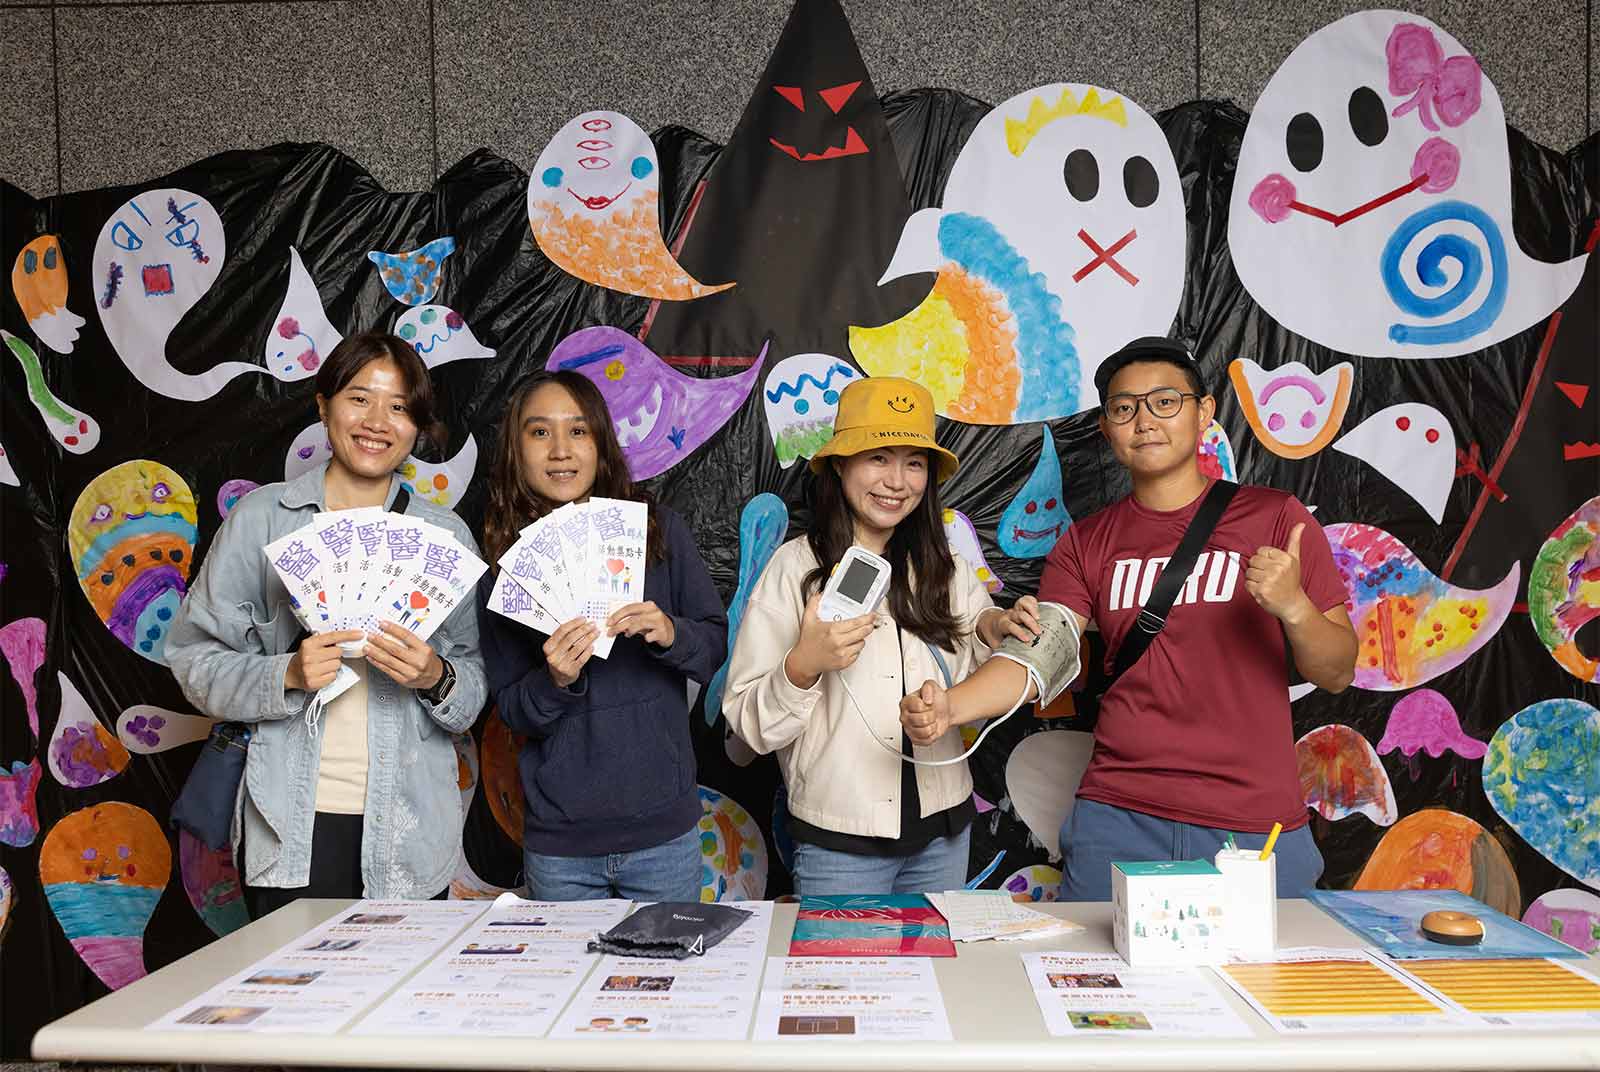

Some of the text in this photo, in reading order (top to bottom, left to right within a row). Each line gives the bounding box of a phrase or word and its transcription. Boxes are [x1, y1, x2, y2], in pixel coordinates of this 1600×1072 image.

[275, 540, 320, 581] 醫
[386, 527, 424, 562] 醫
[409, 573, 455, 609] 活動集點卡
